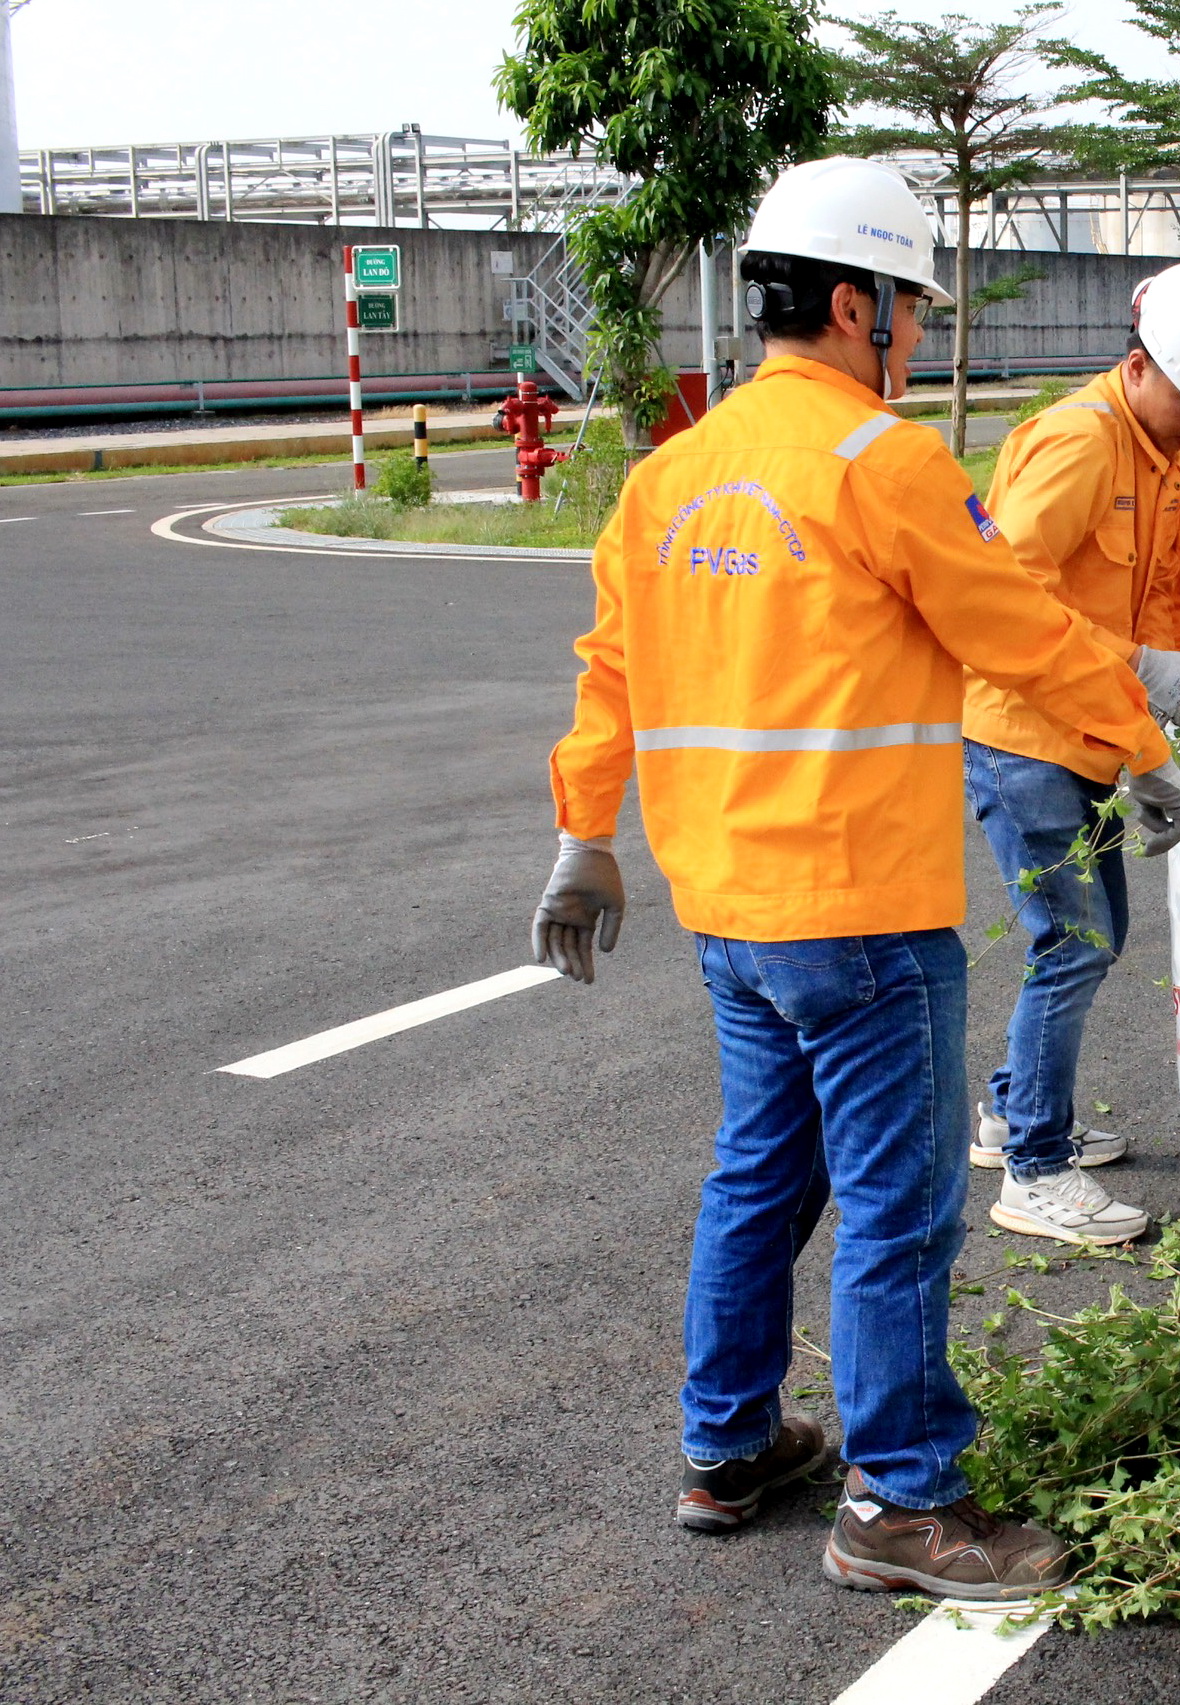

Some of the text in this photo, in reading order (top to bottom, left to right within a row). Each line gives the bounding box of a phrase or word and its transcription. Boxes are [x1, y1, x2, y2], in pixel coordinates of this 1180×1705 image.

[857, 224, 868, 235] LÊ
[870, 227, 894, 242] NGỌC
[363, 268, 378, 277] LAN
[363, 311, 377, 320] LAN
[705, 486, 722, 501] TY
[690, 547, 760, 576] PVGas
